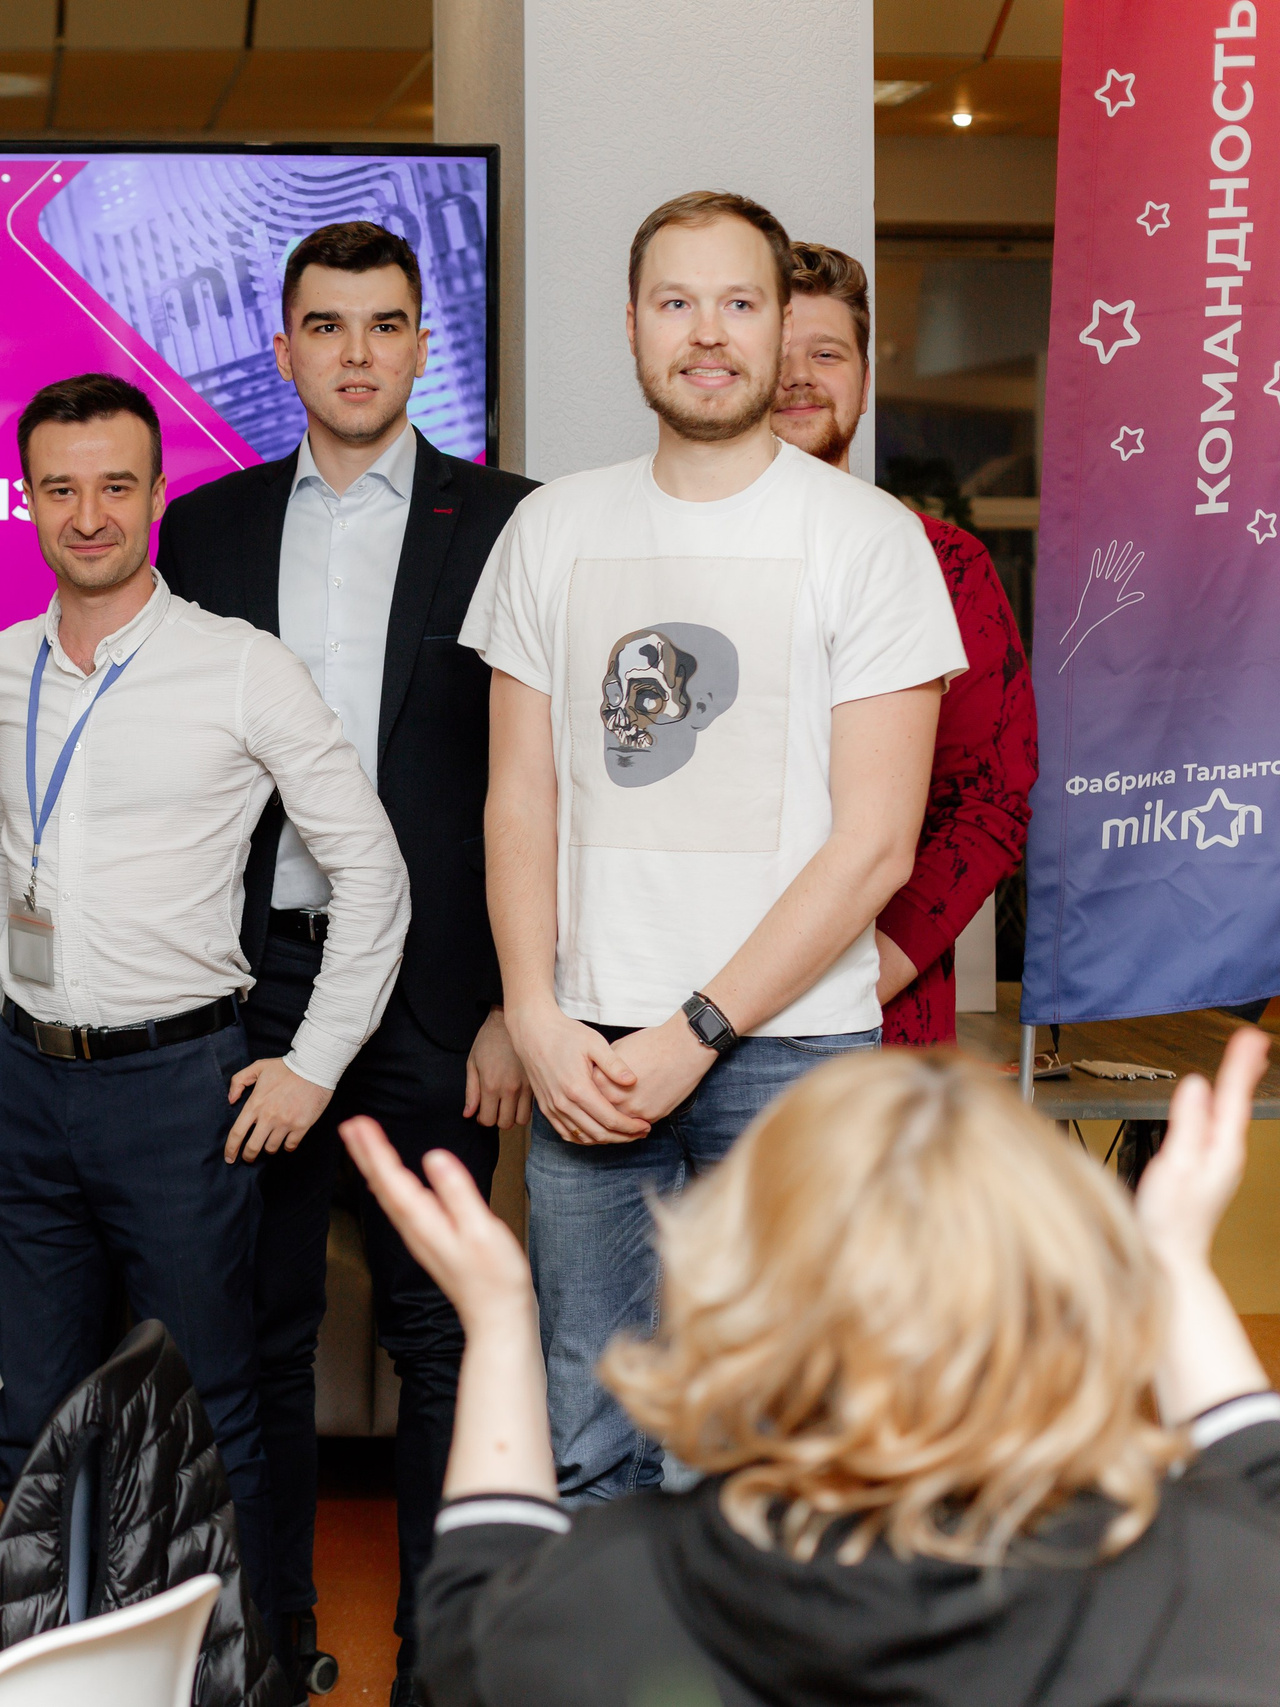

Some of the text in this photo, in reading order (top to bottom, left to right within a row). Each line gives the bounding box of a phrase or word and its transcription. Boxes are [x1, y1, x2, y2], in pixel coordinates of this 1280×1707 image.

[1194, 0, 1258, 516] КОМАНДНОСТЬ
[1065, 759, 1280, 796] Фабрика Таланто
